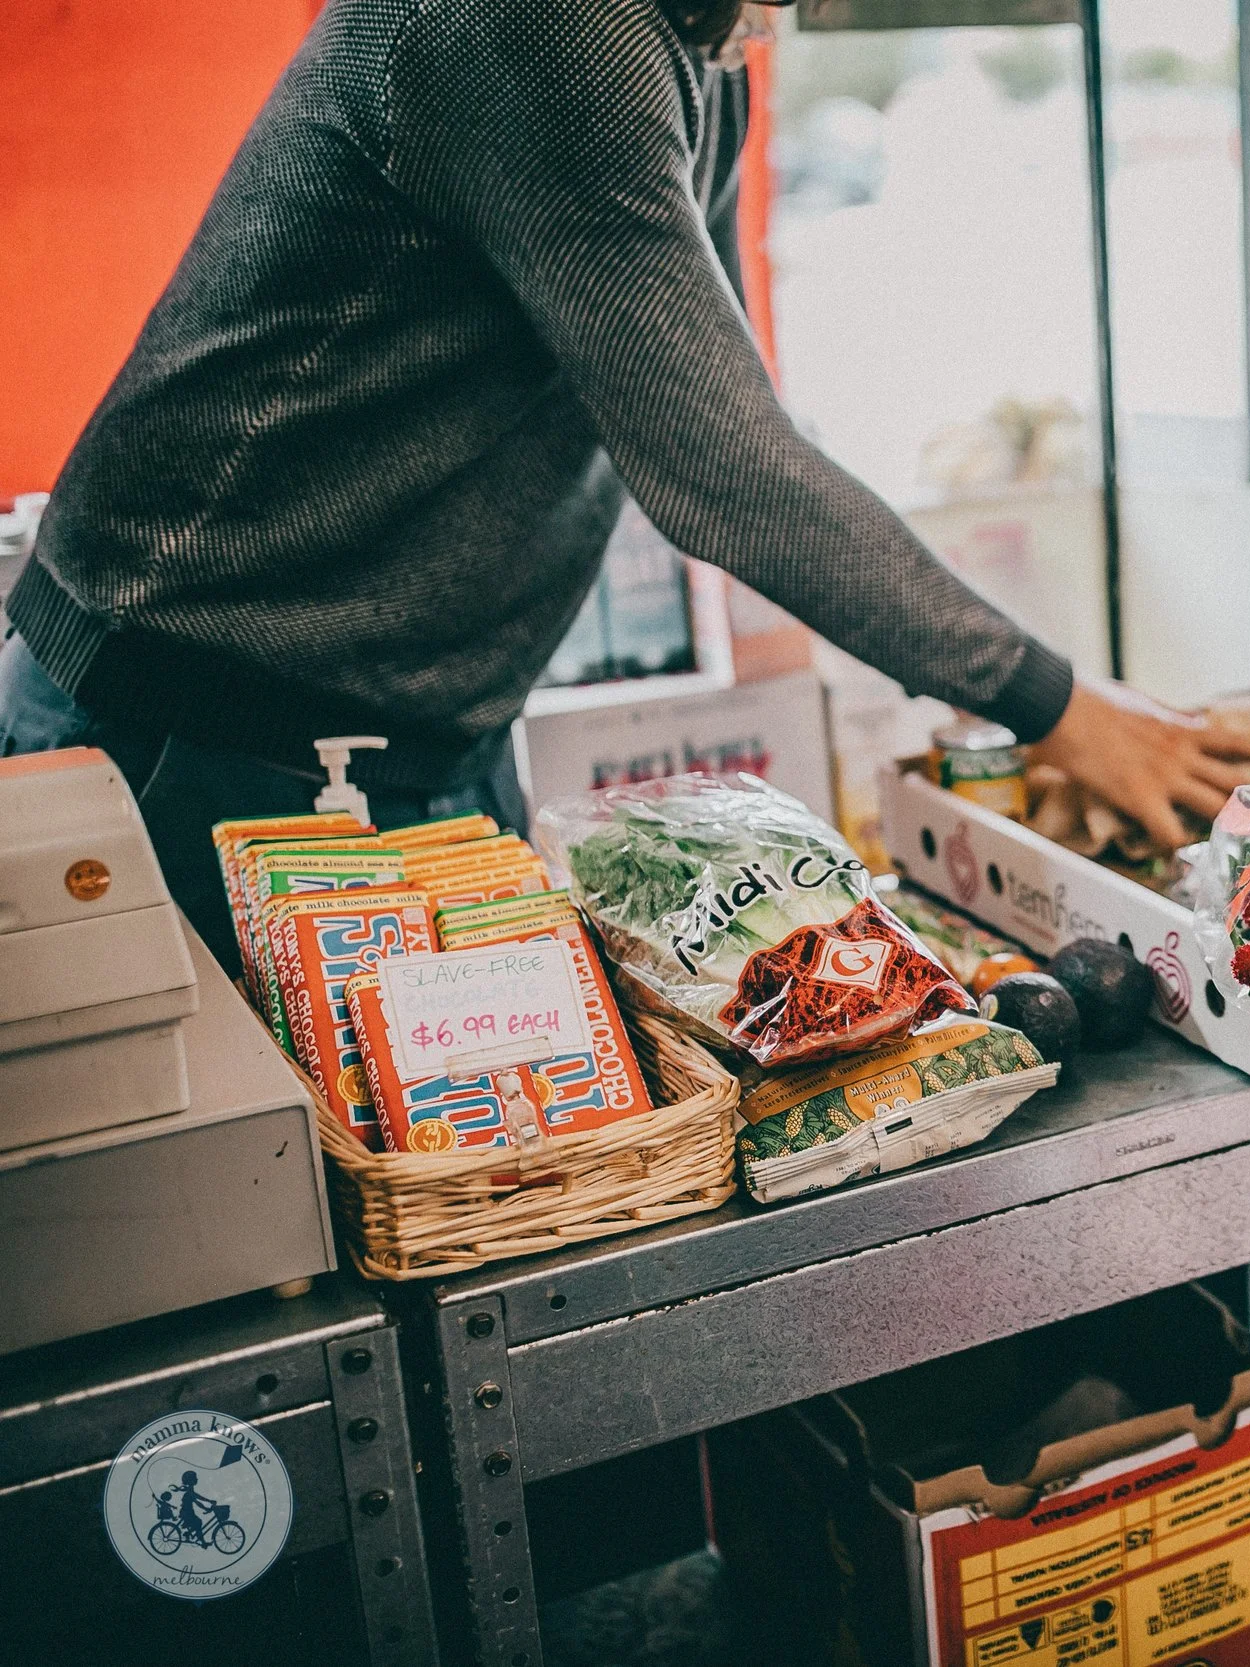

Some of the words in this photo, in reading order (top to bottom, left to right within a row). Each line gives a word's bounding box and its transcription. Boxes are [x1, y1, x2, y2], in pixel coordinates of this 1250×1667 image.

[267, 859, 319, 868] chocolate
[305, 897, 334, 909] milk
[337, 896, 390, 908] chocolate
[397, 894, 423, 904] milk
[283, 917, 306, 988] TONY'S
[830, 947, 875, 977] G
[403, 954, 546, 988] SLAVE-FREE
[350, 992, 371, 1059] TONY'S
[411, 1013, 496, 1051] $6.99
[507, 1009, 561, 1035] EACH
[850, 1067, 912, 1098] Multi-Award
[867, 1084, 905, 1104] Winners
